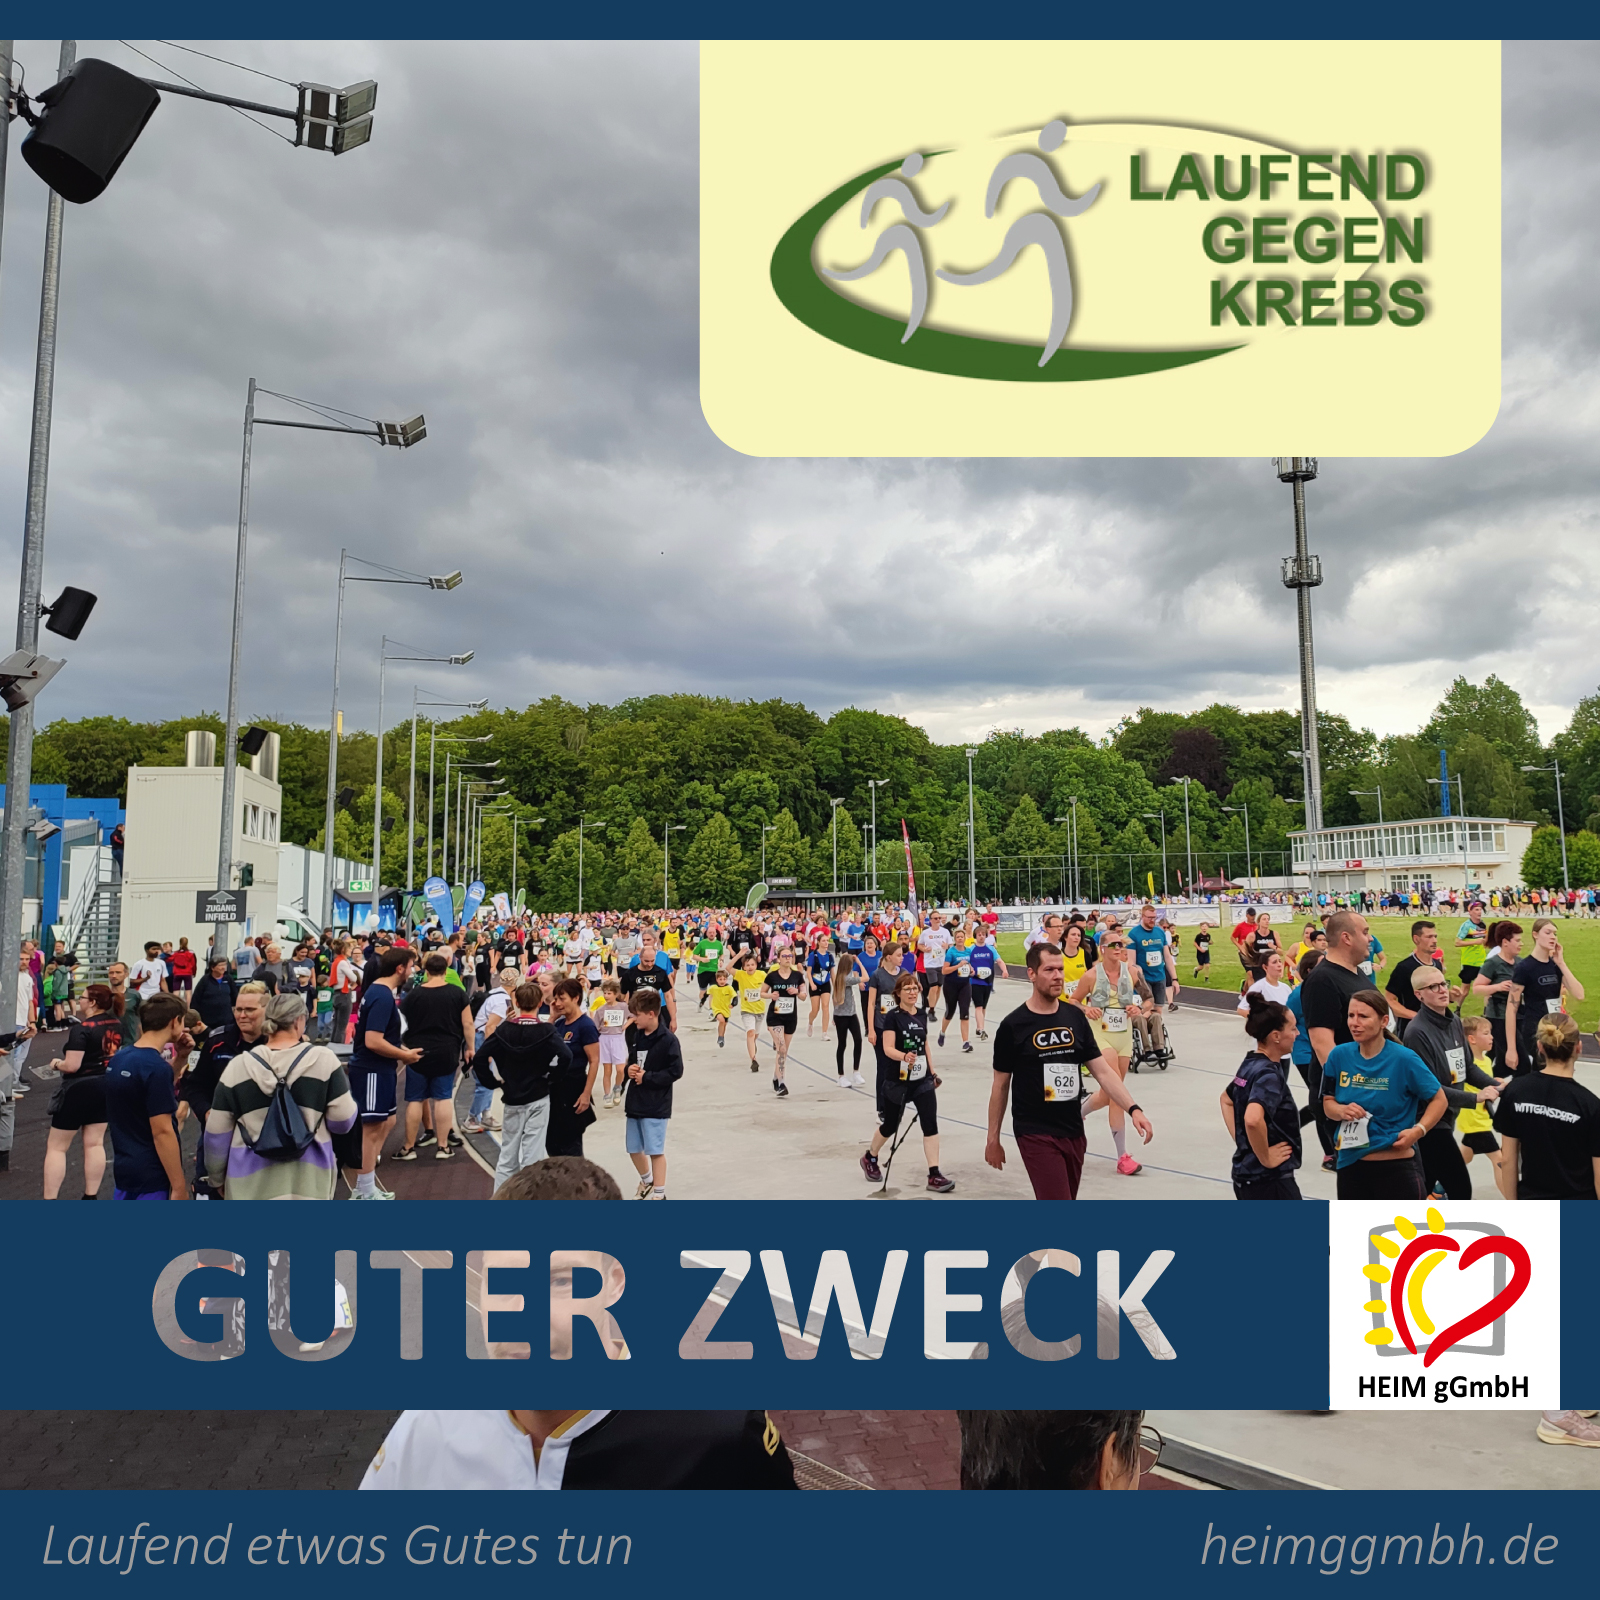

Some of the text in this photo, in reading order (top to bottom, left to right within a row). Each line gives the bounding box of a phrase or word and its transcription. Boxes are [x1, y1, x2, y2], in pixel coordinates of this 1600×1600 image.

[205, 904, 237, 912] ZUGANG
[205, 912, 237, 921] INFIELD
[1108, 1016, 1123, 1024] 564
[1036, 1030, 1071, 1046] CAC
[1054, 1076, 1075, 1087] 626
